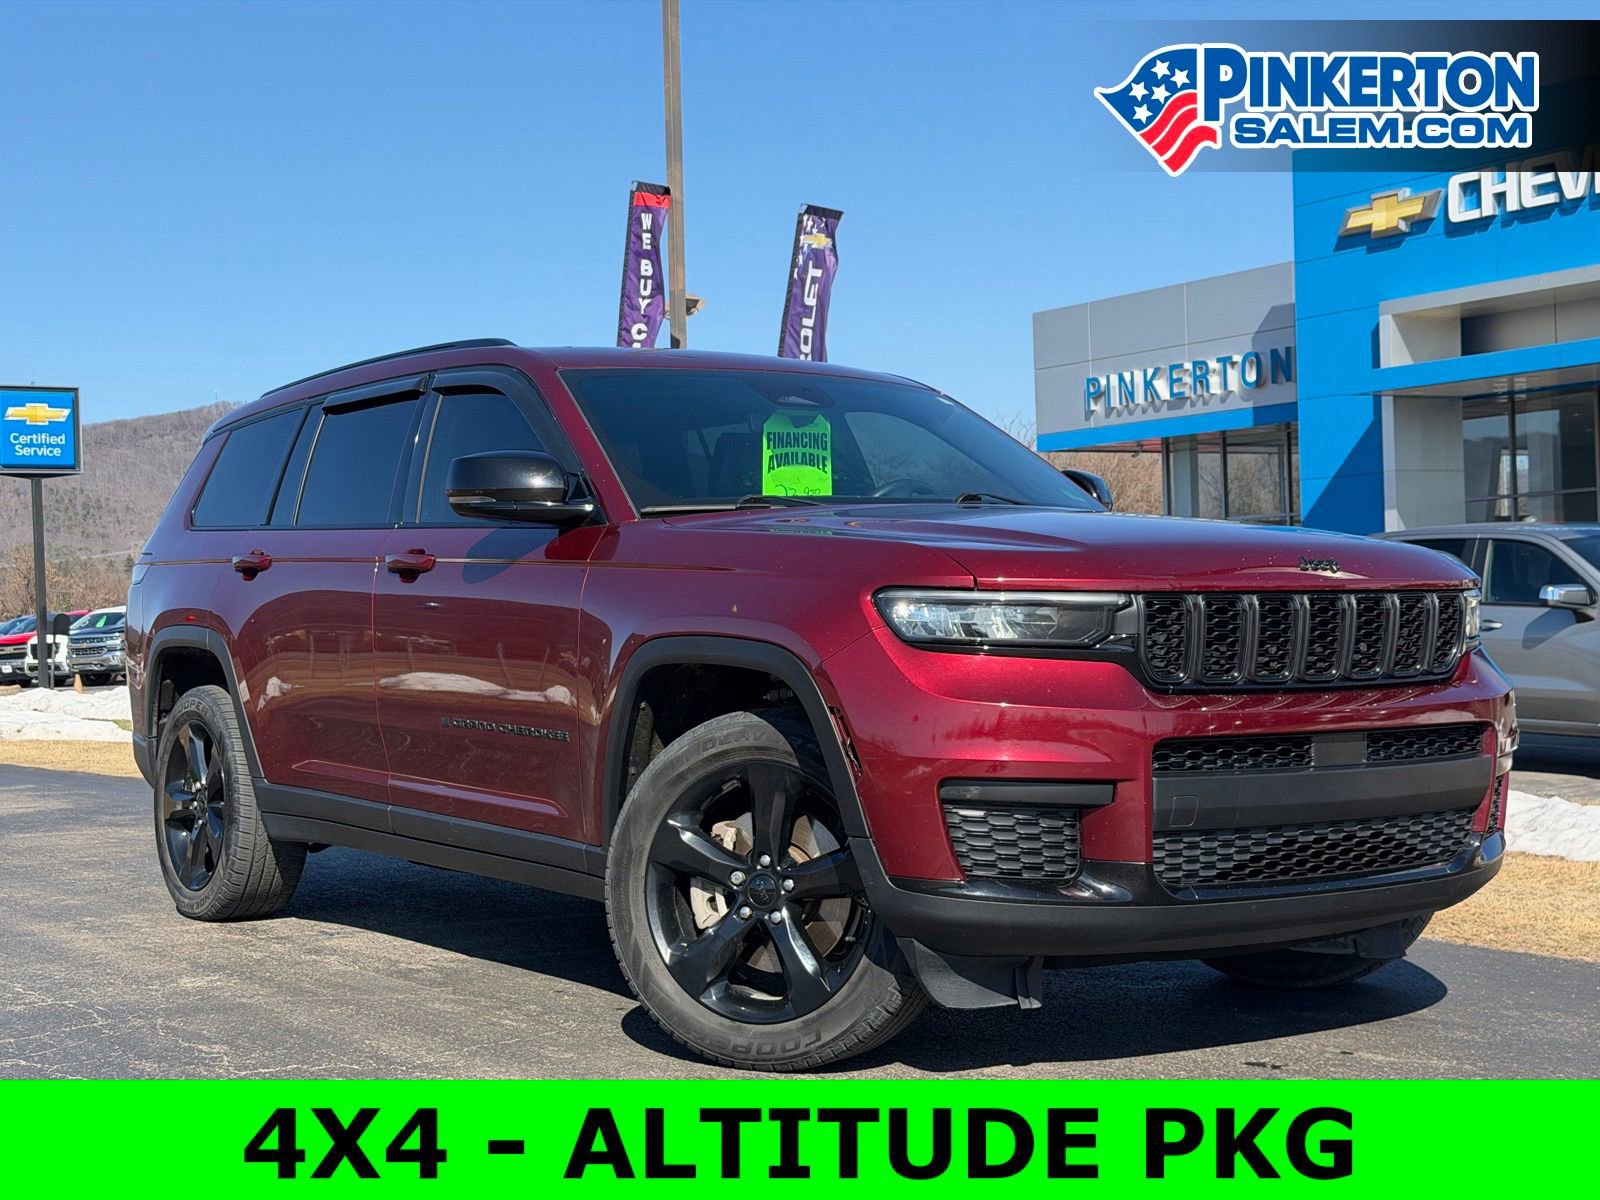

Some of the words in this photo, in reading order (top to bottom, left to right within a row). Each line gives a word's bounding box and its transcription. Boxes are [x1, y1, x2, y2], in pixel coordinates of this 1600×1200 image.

[640, 212, 653, 251] WE
[638, 259, 653, 315] BUY
[1084, 345, 1297, 412] PINKERTON
[9, 432, 66, 445] Certified
[766, 431, 828, 452] FINANCING
[14, 444, 62, 457] Service
[767, 451, 828, 474] AVAILABLE
